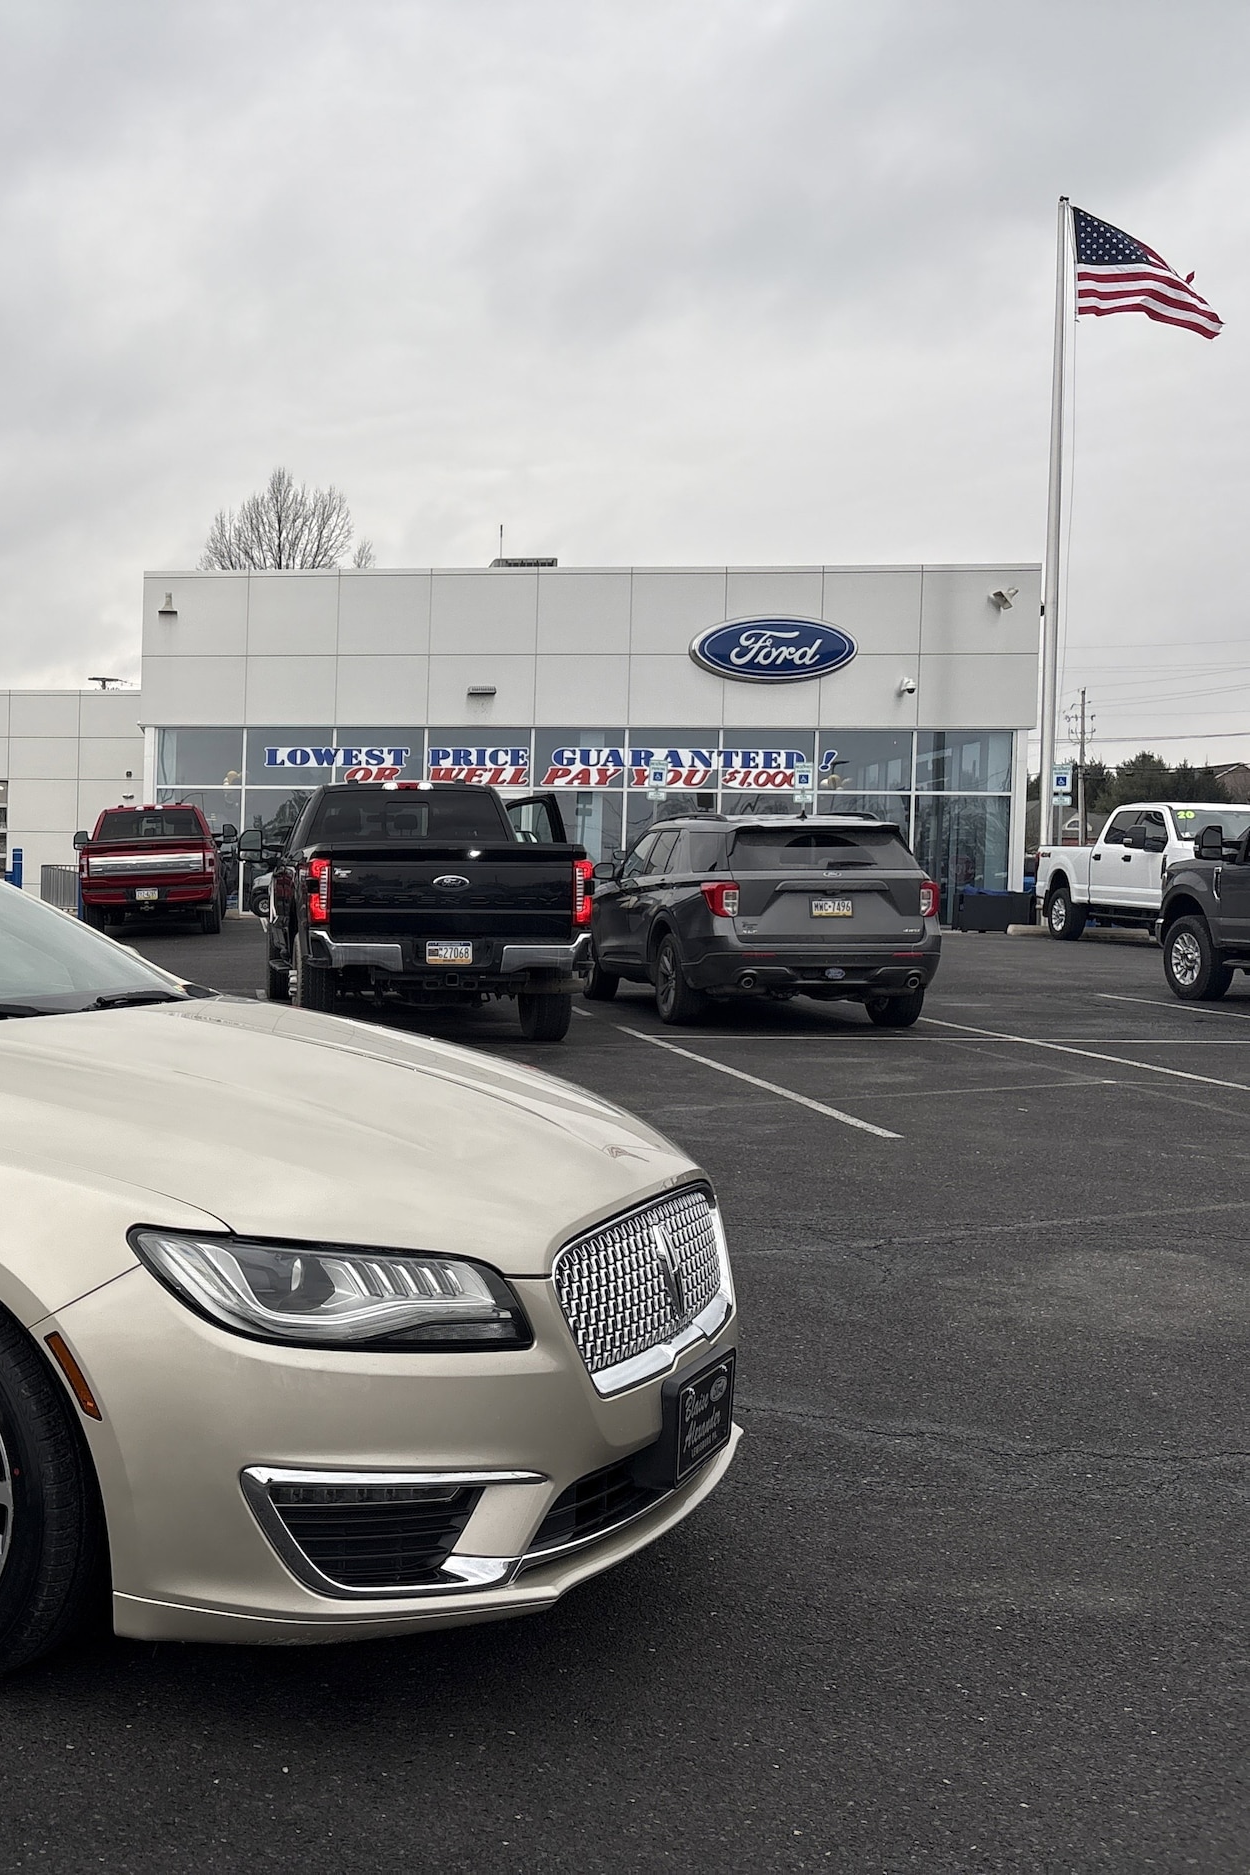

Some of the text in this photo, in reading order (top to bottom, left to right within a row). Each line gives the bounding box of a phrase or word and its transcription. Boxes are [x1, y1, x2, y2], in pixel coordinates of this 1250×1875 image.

[729, 629, 823, 666] Ford
[264, 747, 409, 767] LOWEST
[429, 747, 529, 767] PRICE
[344, 767, 401, 782] OR
[542, 767, 622, 786] PAY
[631, 768, 712, 787] YOU
[1176, 810, 1196, 820] 20
